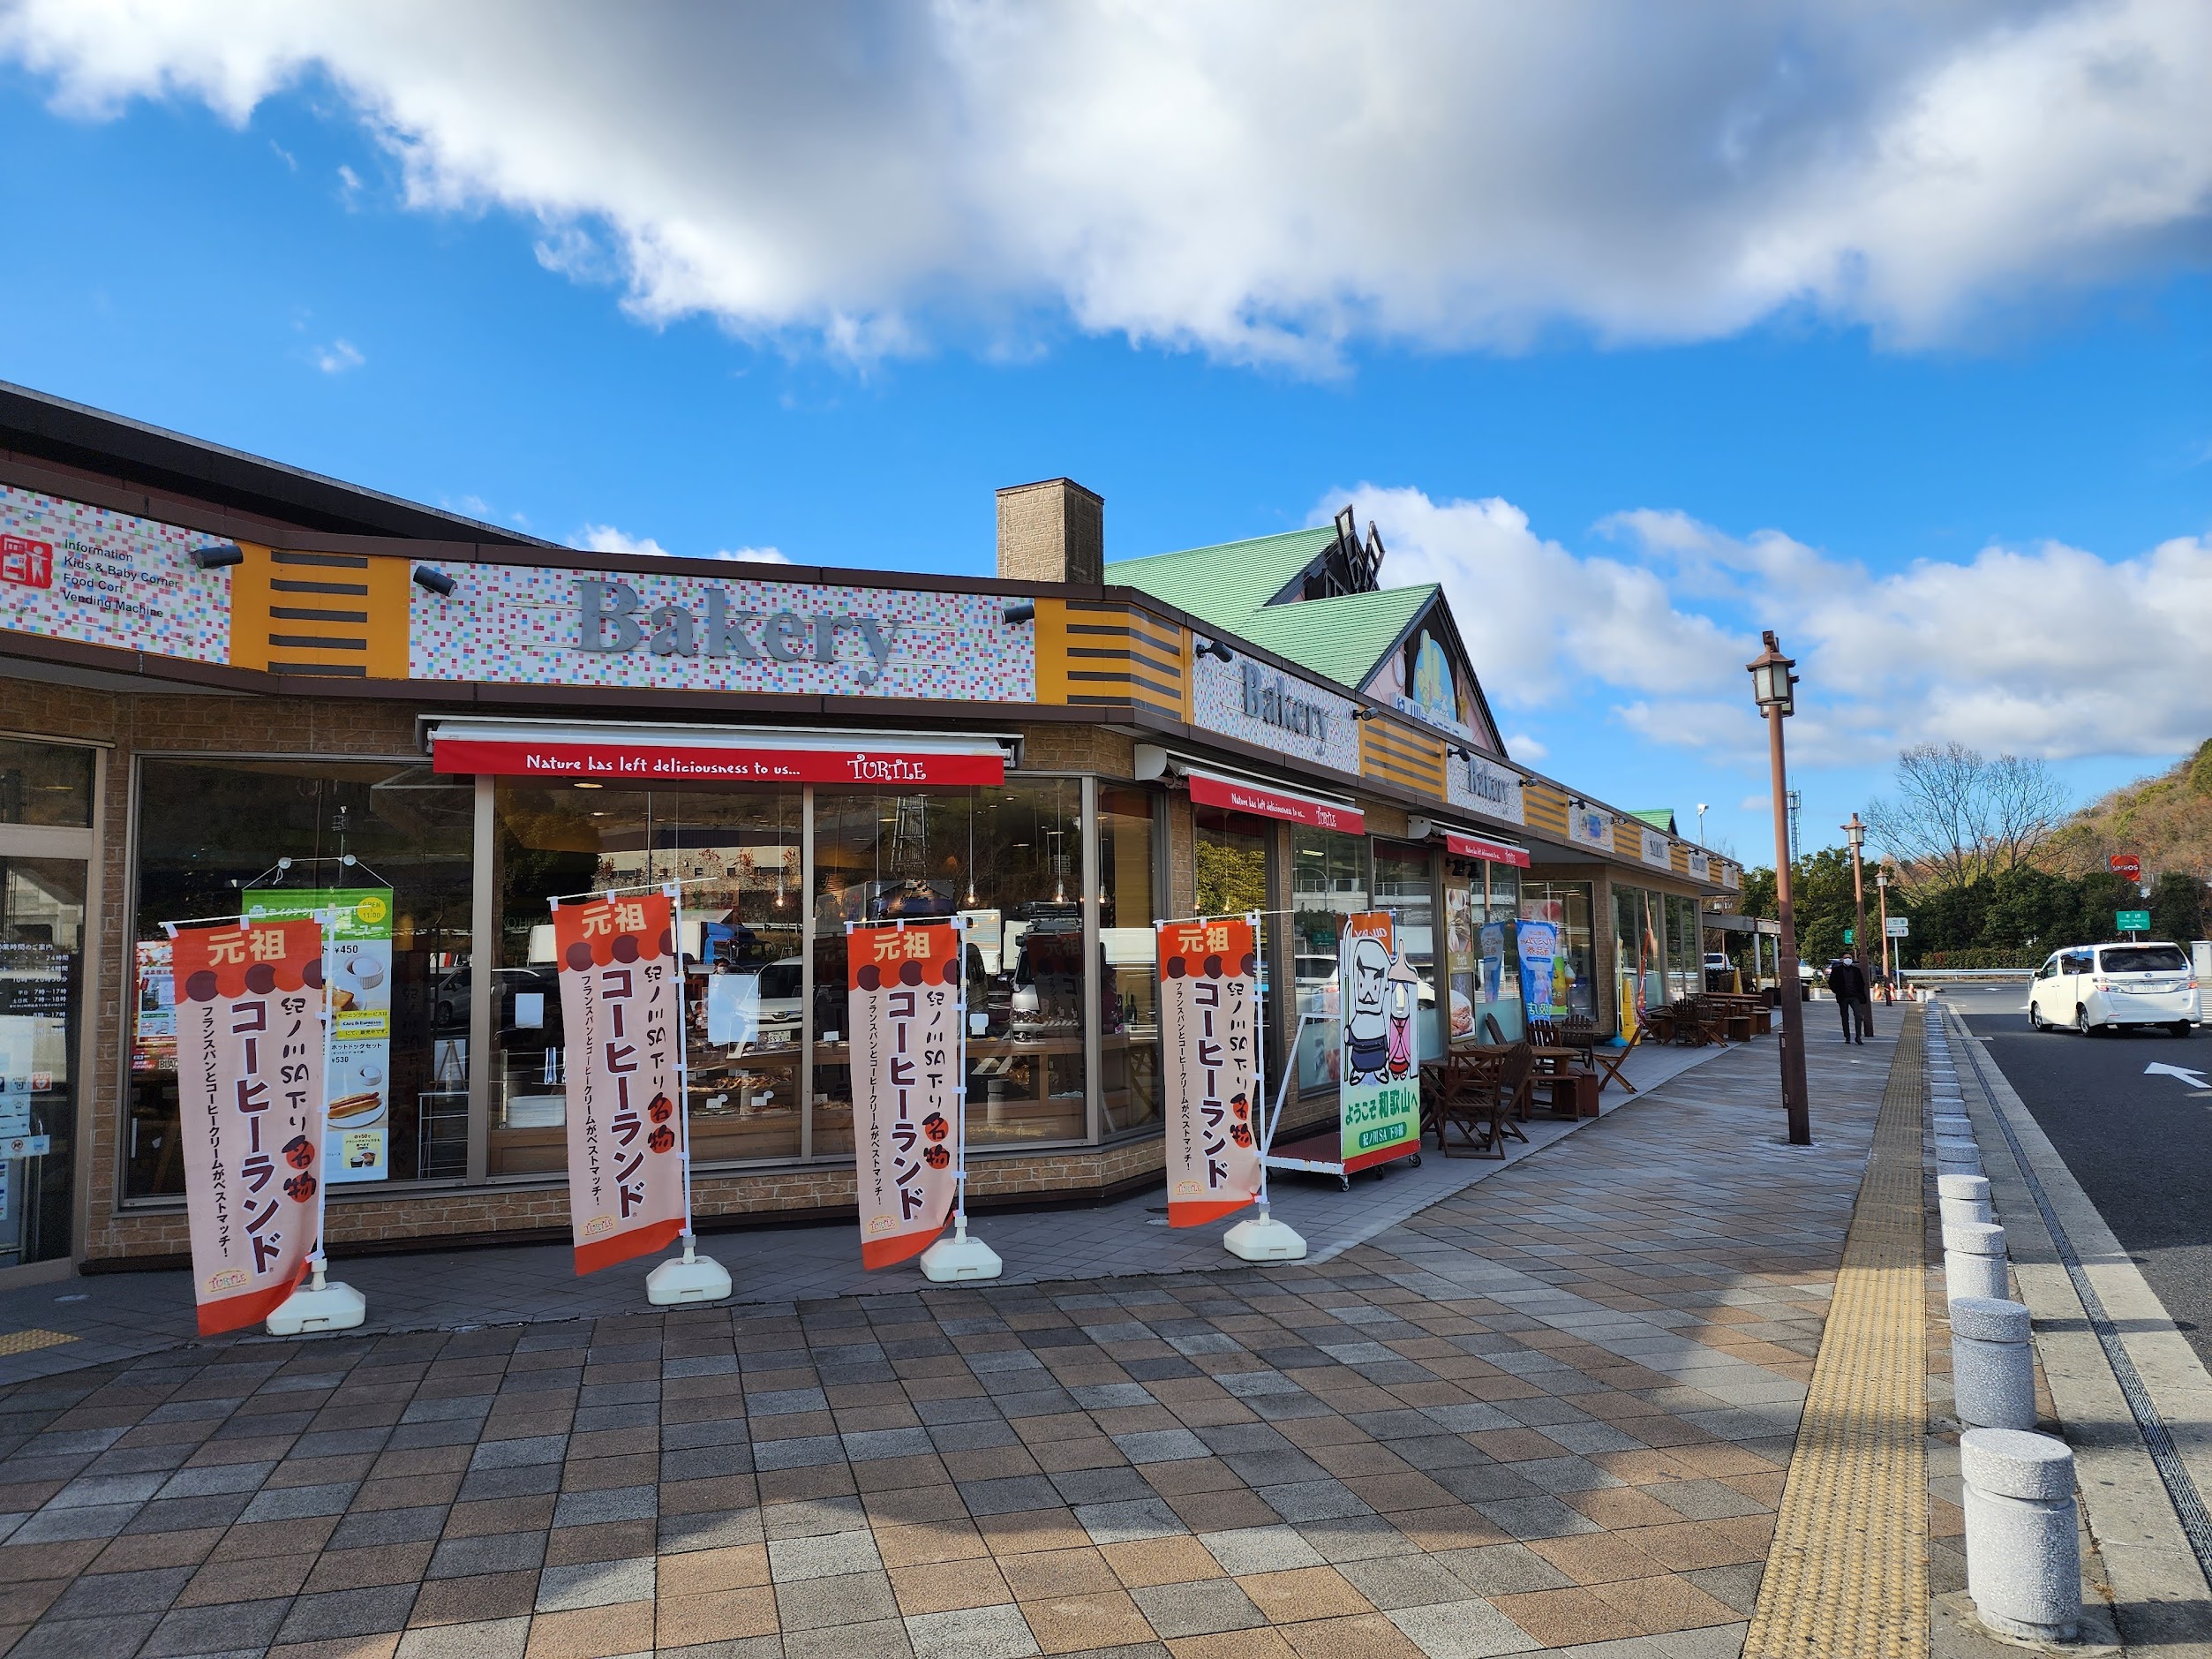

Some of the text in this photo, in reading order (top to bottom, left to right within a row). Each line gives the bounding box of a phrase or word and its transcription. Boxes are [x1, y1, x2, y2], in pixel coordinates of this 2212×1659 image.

[64, 539, 133, 562] Information
[64, 556, 180, 588] Kids & Baby Corner
[64, 574, 124, 593] Food Cort
[63, 590, 164, 619] Vending Machine
[572, 579, 905, 687] Bakery
[1242, 662, 1331, 757] Bakery
[526, 755, 801, 775] Nature has left deliciousness to us...
[846, 753, 927, 781] TURTLE
[1231, 793, 1248, 806] Nature
[1315, 806, 1337, 828] TURTLE
[581, 902, 647, 939] 元祖
[207, 929, 287, 968] 元祖
[335, 945, 358, 954] ¥450
[873, 931, 931, 962] 元祖
[1177, 927, 1230, 954] 元祖
[601, 969, 644, 1218] コーヒーランド
[1195, 982, 1228, 1188] コーヒーランド
[889, 992, 923, 1220] コーヒーランド
[1345, 1086, 1418, 1126] ようこそ和歌山へ
[231, 1000, 281, 1274] コーヒーランド
[583, 1218, 613, 1233] TURTLE
[209, 1272, 247, 1287] TURTLE
